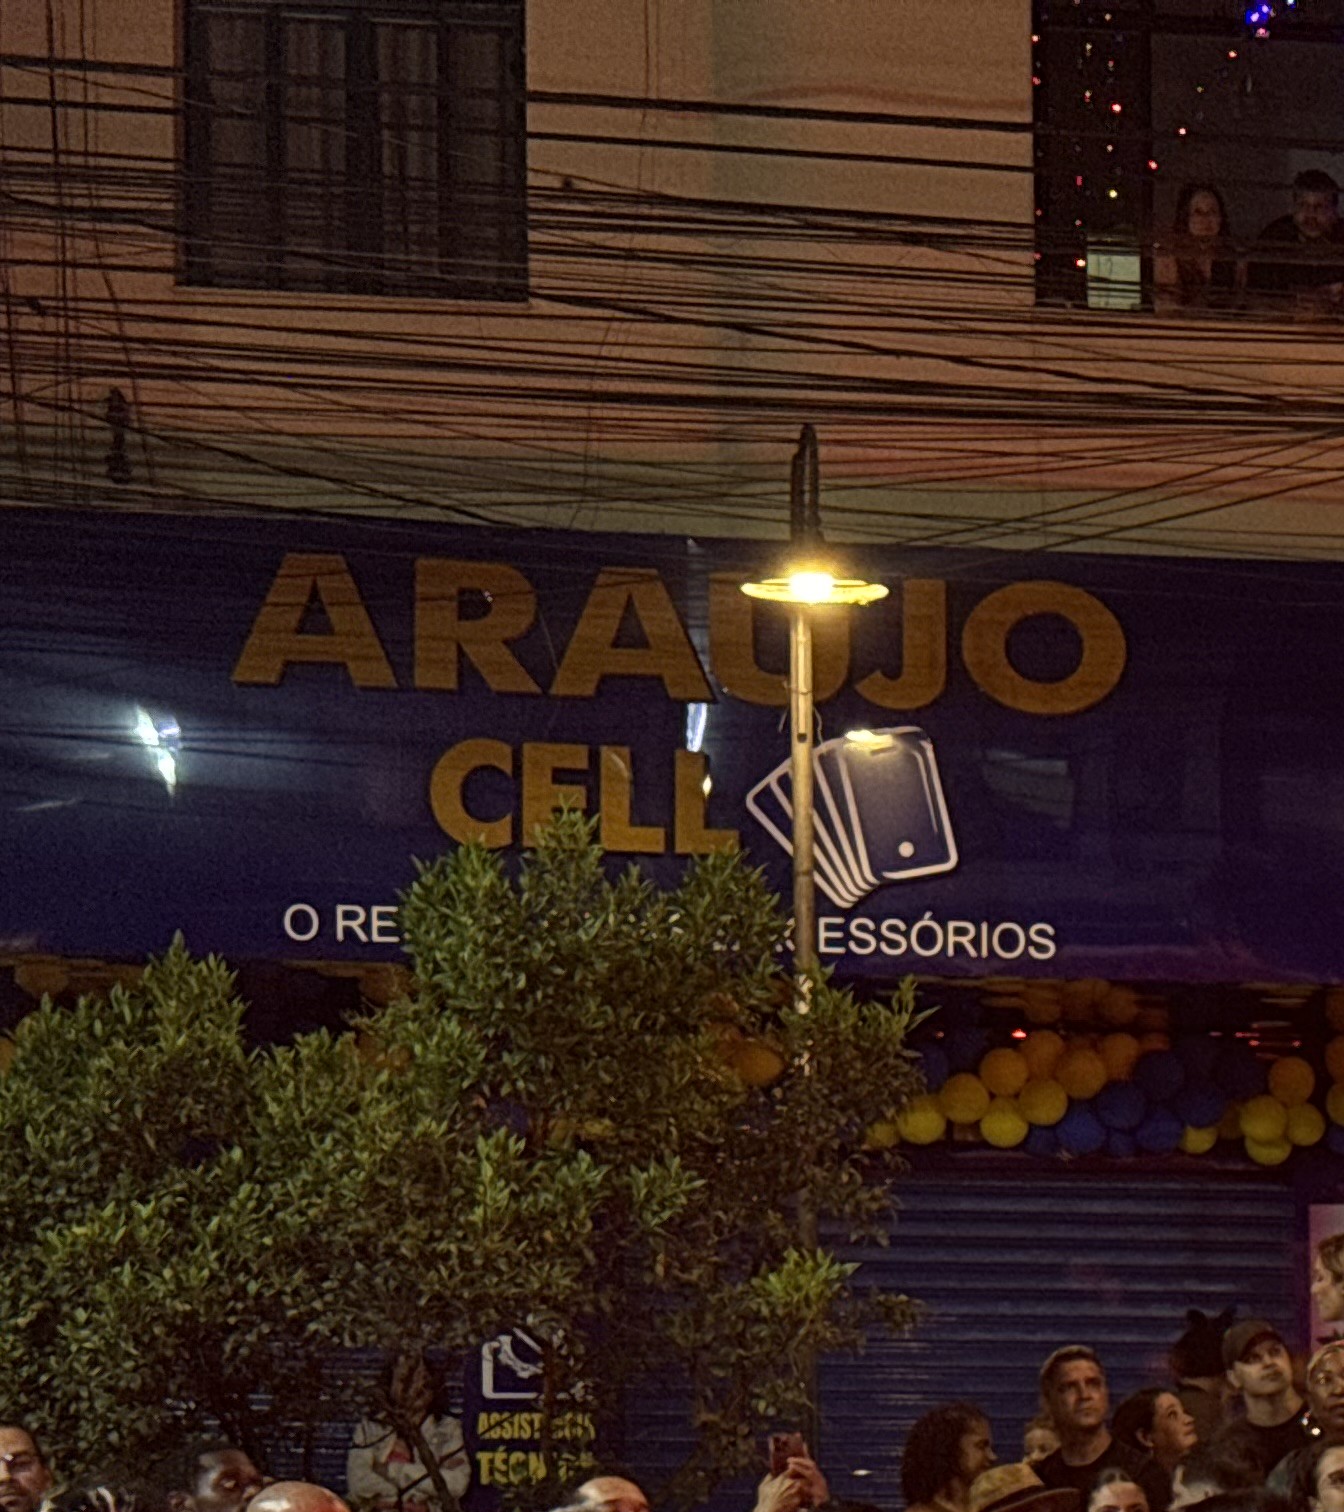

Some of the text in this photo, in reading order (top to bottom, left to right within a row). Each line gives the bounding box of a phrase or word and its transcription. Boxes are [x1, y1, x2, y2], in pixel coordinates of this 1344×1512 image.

[430, 738, 741, 854] CELL
[283, 903, 320, 942] O
[770, 911, 1057, 960] ESSÓRIOS
